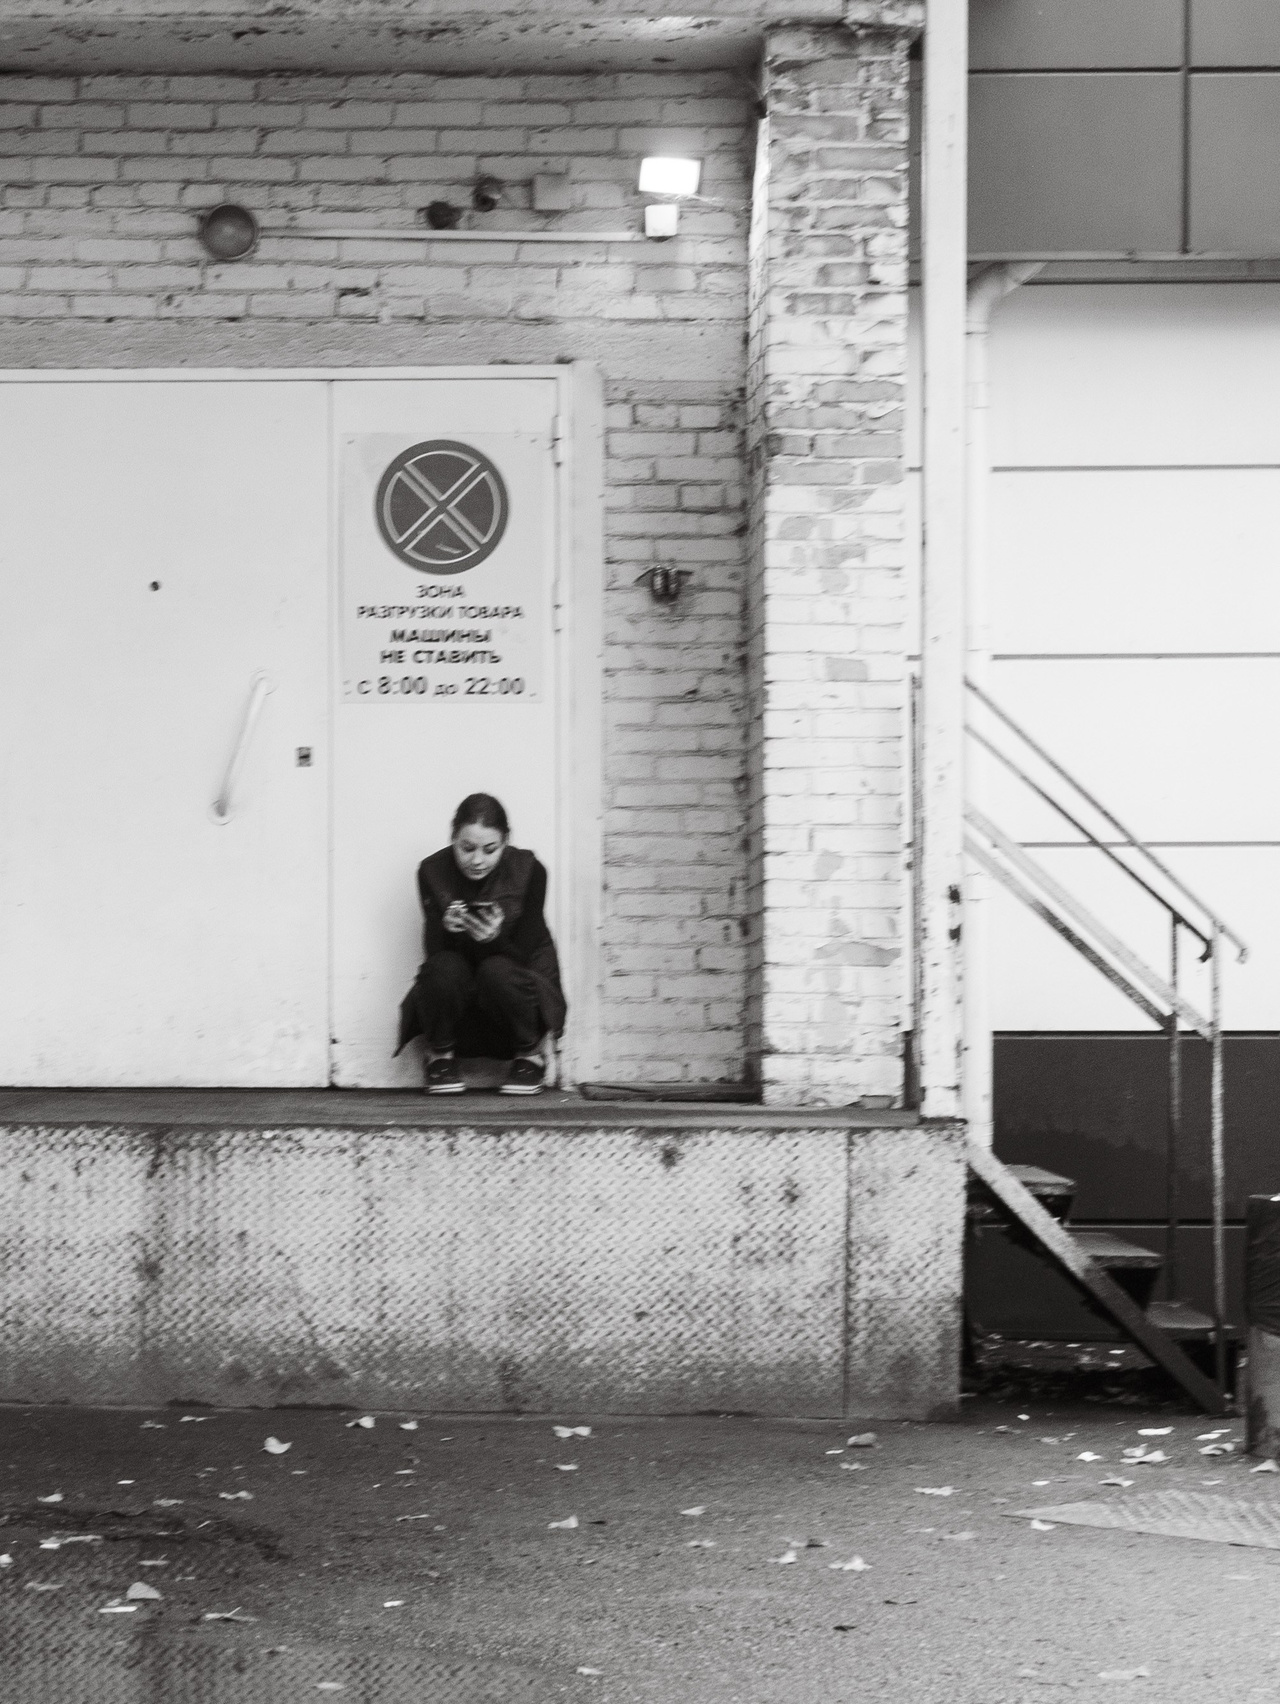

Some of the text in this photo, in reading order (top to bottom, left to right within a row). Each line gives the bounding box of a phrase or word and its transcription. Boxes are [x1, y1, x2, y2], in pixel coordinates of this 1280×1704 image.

[416, 584, 465, 598] ЗОНА
[357, 605, 524, 619] РАЗГРУЗКИ ТОВАРА
[390, 629, 492, 643] МАШИНЫ
[380, 650, 502, 664] НЕ СТАВИТЬ
[377, 676, 428, 695] 8:00
[433, 683, 458, 697] до
[463, 676, 526, 695] 22:00
